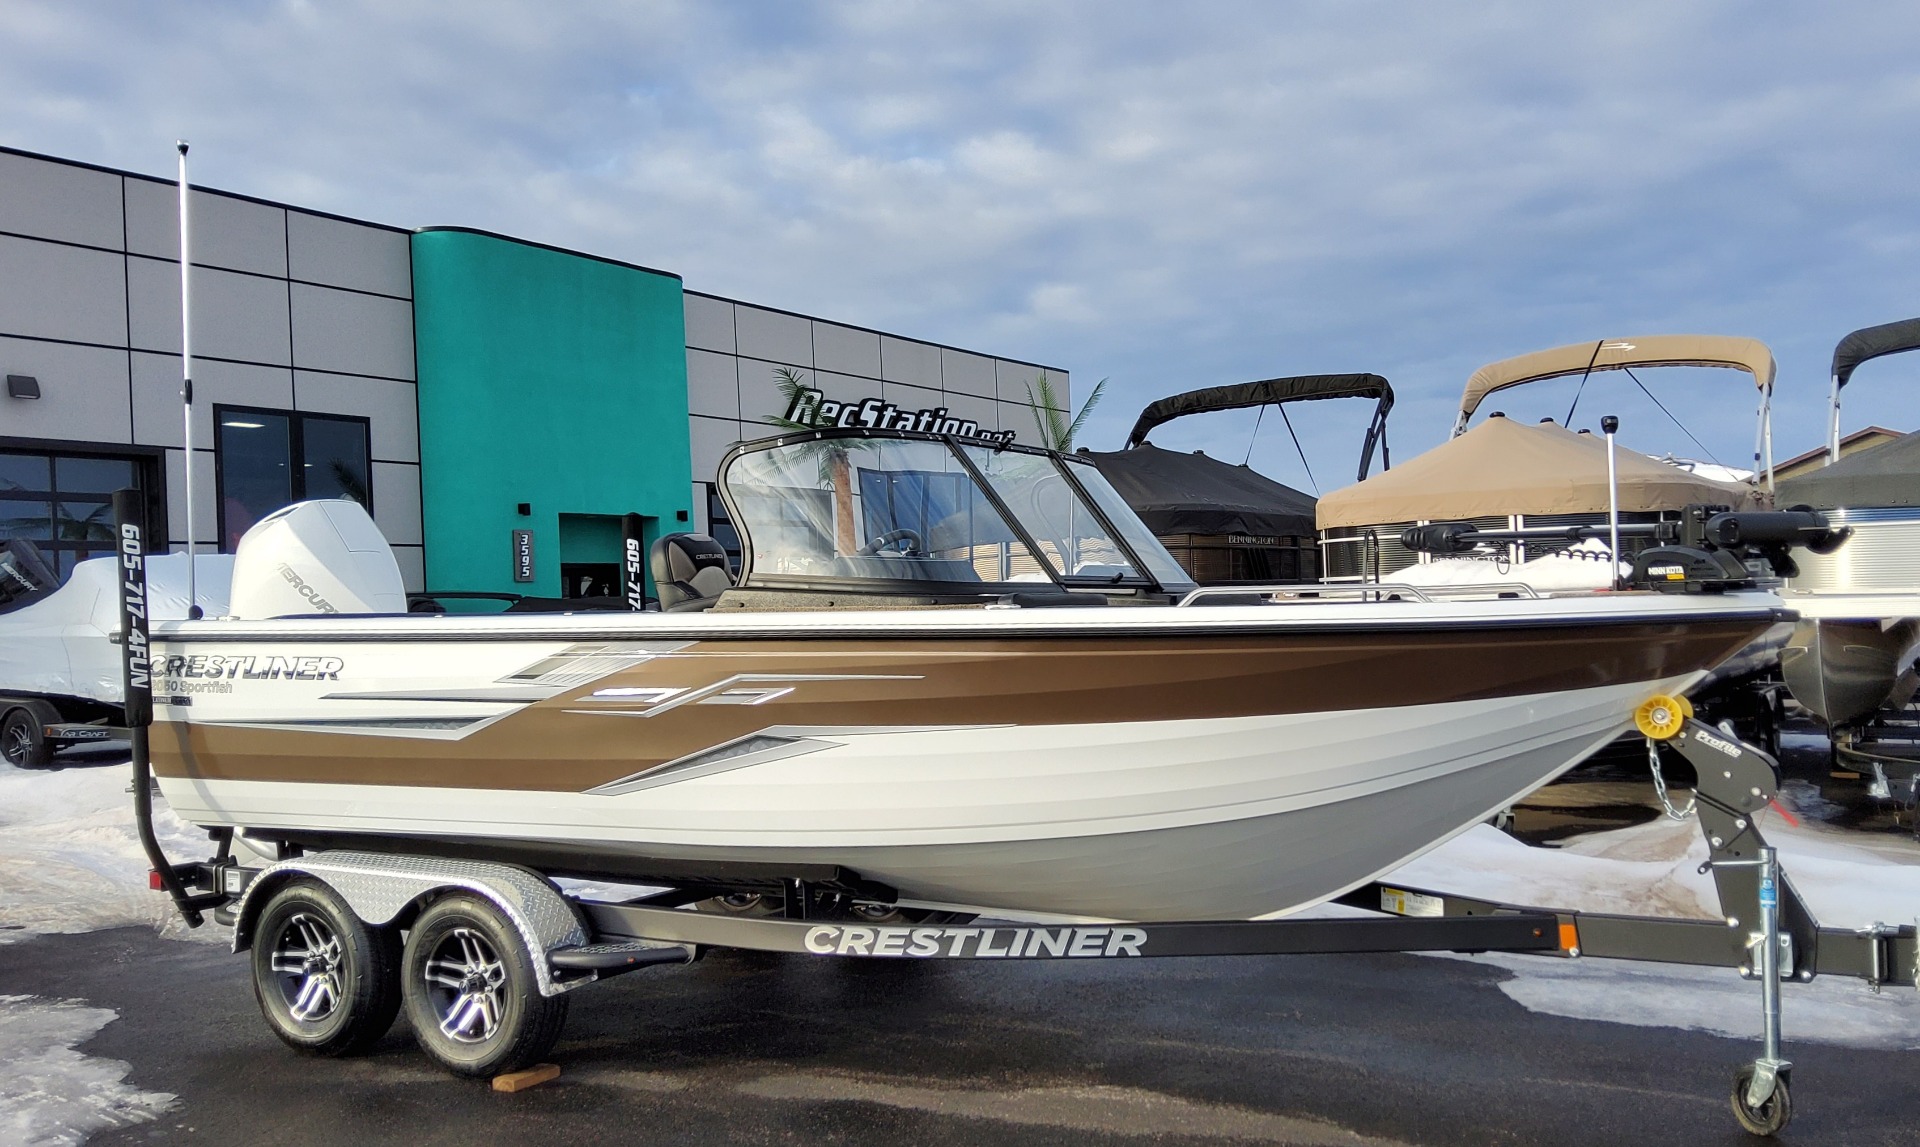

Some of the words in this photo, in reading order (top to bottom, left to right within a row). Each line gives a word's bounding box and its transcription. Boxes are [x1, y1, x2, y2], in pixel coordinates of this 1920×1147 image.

[1228, 535, 1274, 544] BENNINGTON
[519, 533, 530, 578] 3595
[274, 562, 339, 614] ERCUR
[121, 523, 149, 689] 605-717-4FUN
[150, 655, 344, 681] CRESTLINER
[180, 681, 233, 694] Sportfish
[804, 926, 1147, 957] CRESTLINER
